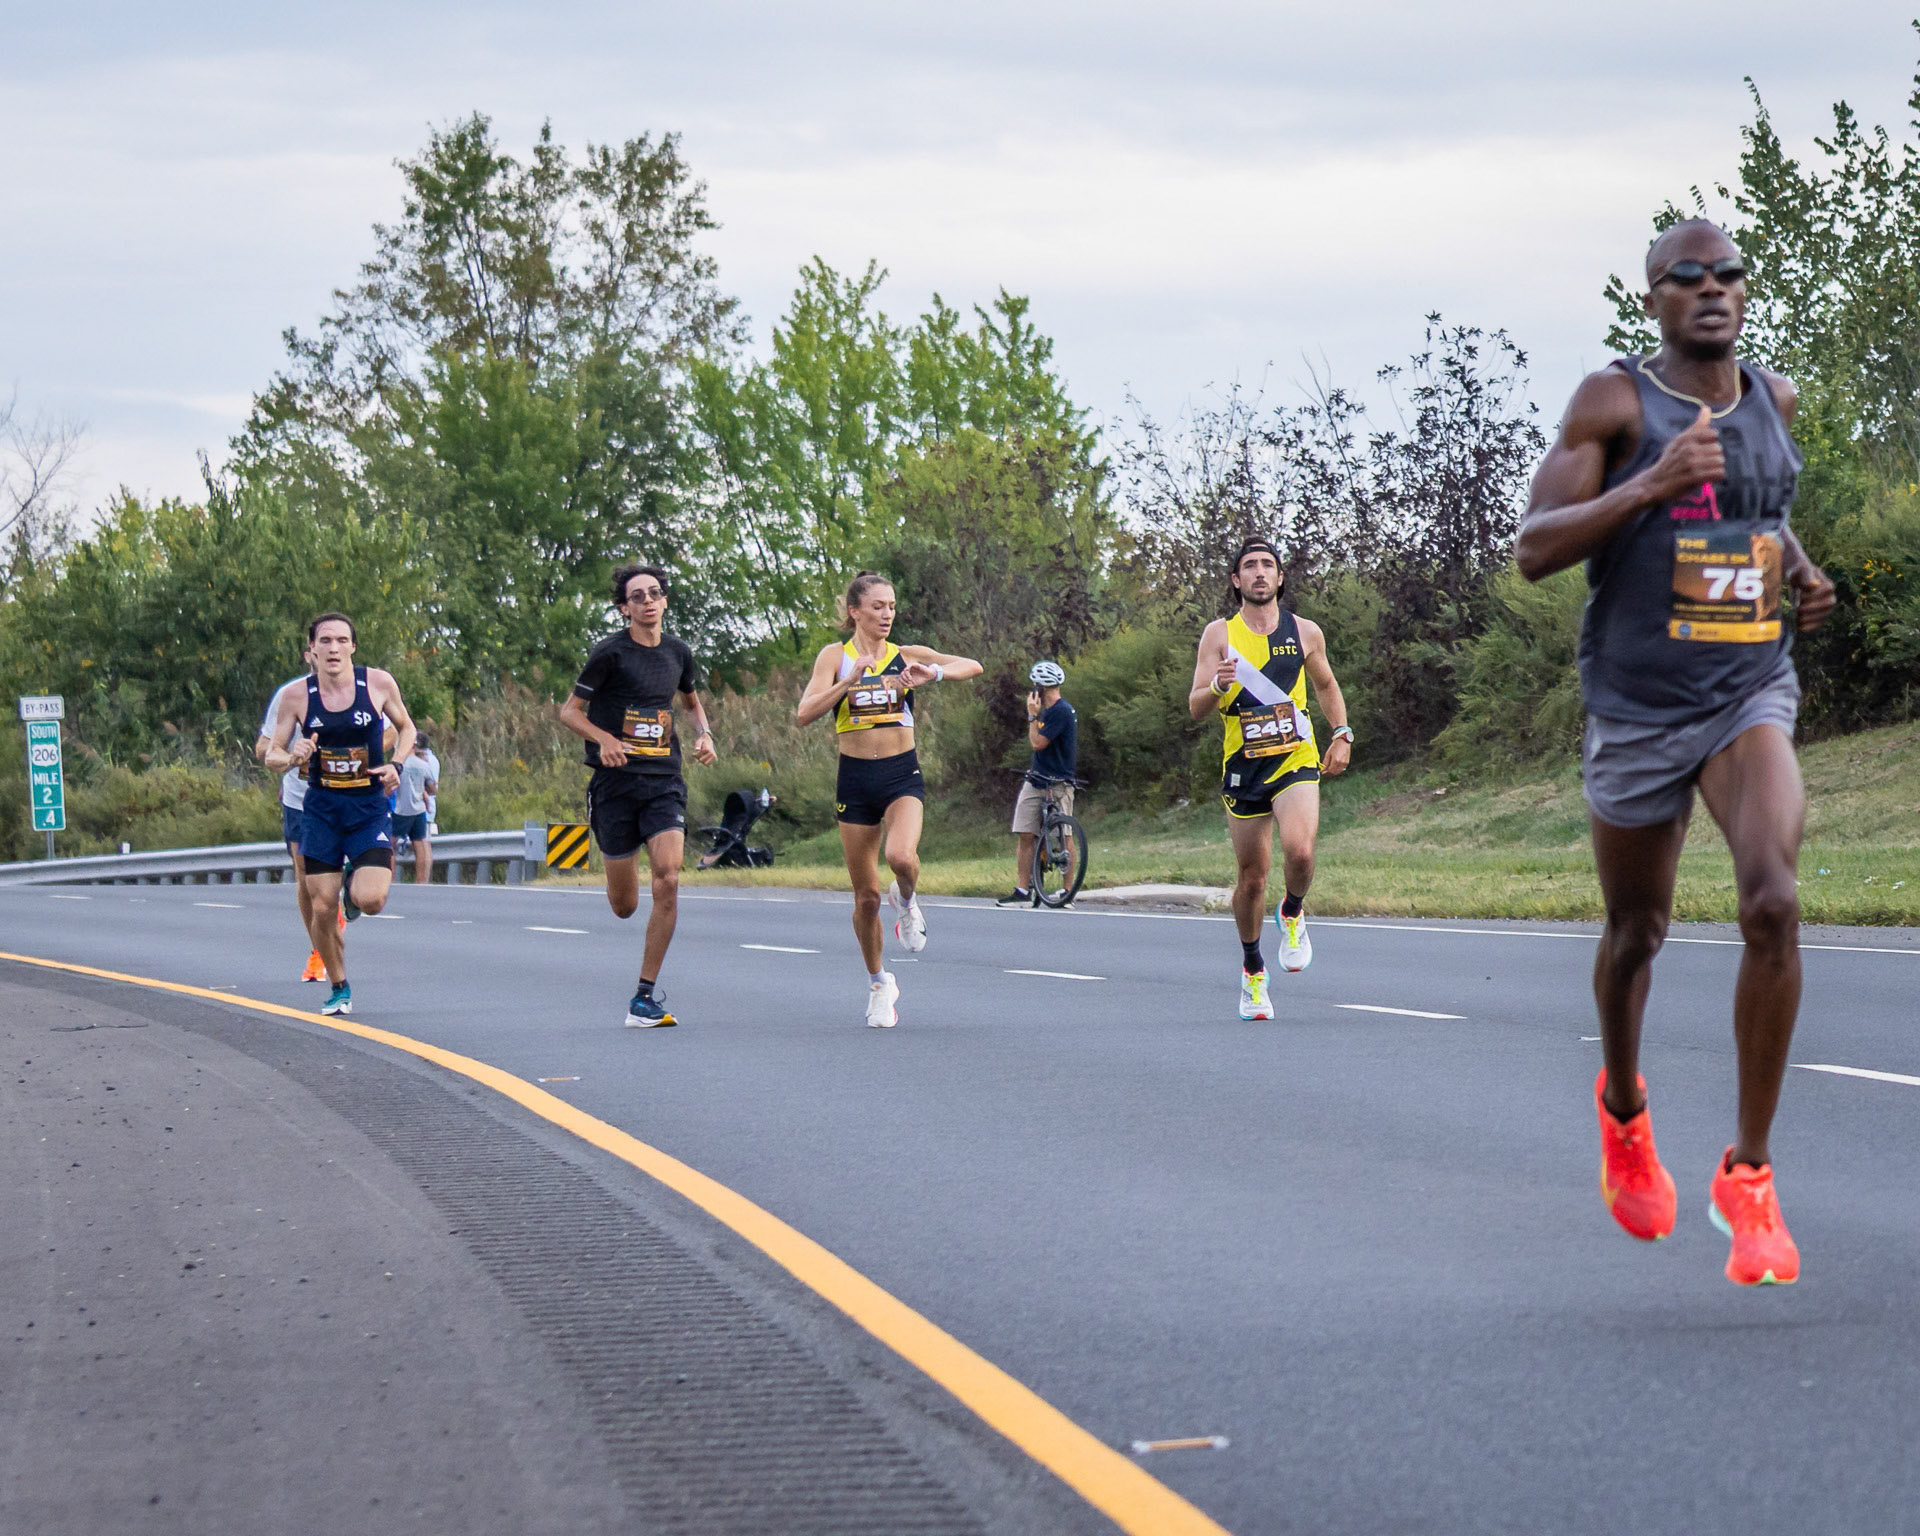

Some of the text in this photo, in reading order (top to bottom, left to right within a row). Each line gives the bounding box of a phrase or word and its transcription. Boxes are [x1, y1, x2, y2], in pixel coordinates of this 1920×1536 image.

[1702, 567, 1764, 600] 75
[1272, 645, 1298, 656] GSTC
[855, 689, 898, 706] 251
[25, 703, 60, 714] BY-PASS
[354, 710, 372, 726] SP
[31, 725, 57, 738] SOUTH
[634, 723, 664, 738] 29
[1245, 718, 1294, 739] 245
[34, 749, 57, 762] 206
[327, 760, 362, 773] 137
[34, 772, 59, 785] MILE
[43, 787, 53, 804] 2
[42, 809, 56, 827] .4
